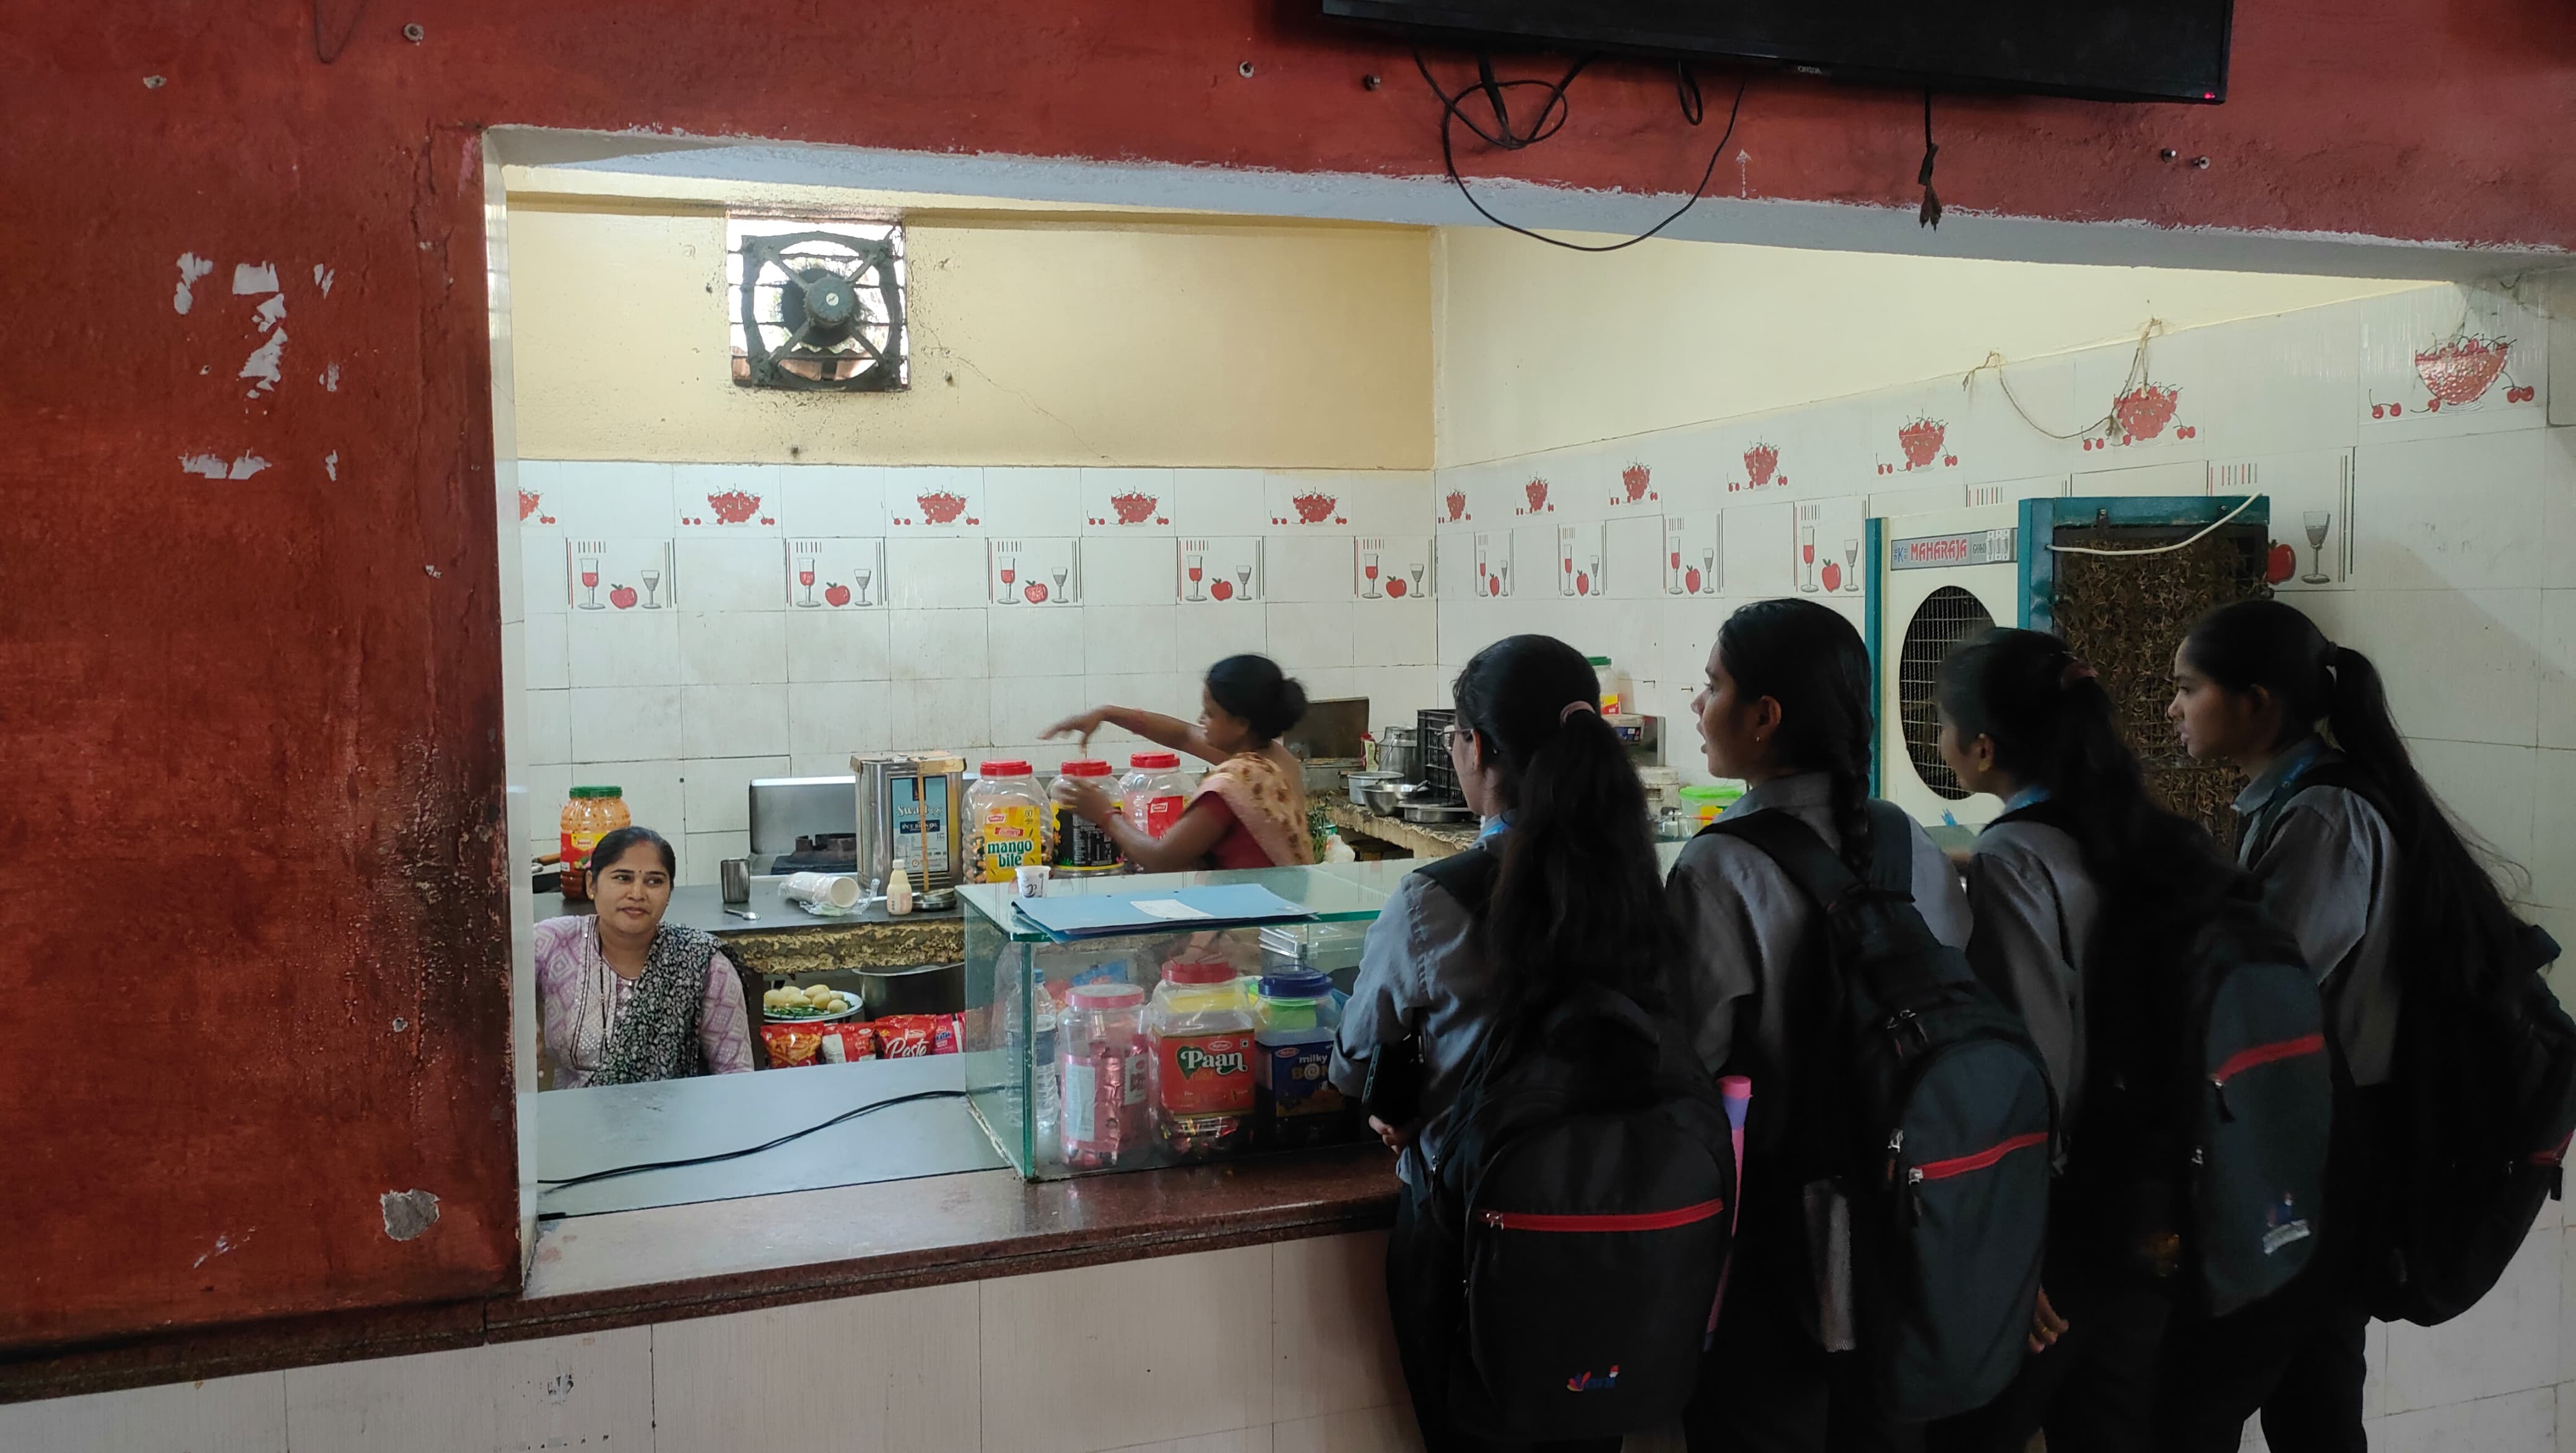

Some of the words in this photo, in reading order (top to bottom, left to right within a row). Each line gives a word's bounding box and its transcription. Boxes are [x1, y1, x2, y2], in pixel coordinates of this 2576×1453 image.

[1910, 539, 1967, 562] MAHARAJA
[987, 840, 1033, 854] mango
[998, 853, 1022, 868] bite
[1180, 1050, 1248, 1076] Paan
[1299, 1054, 1328, 1064] milky
